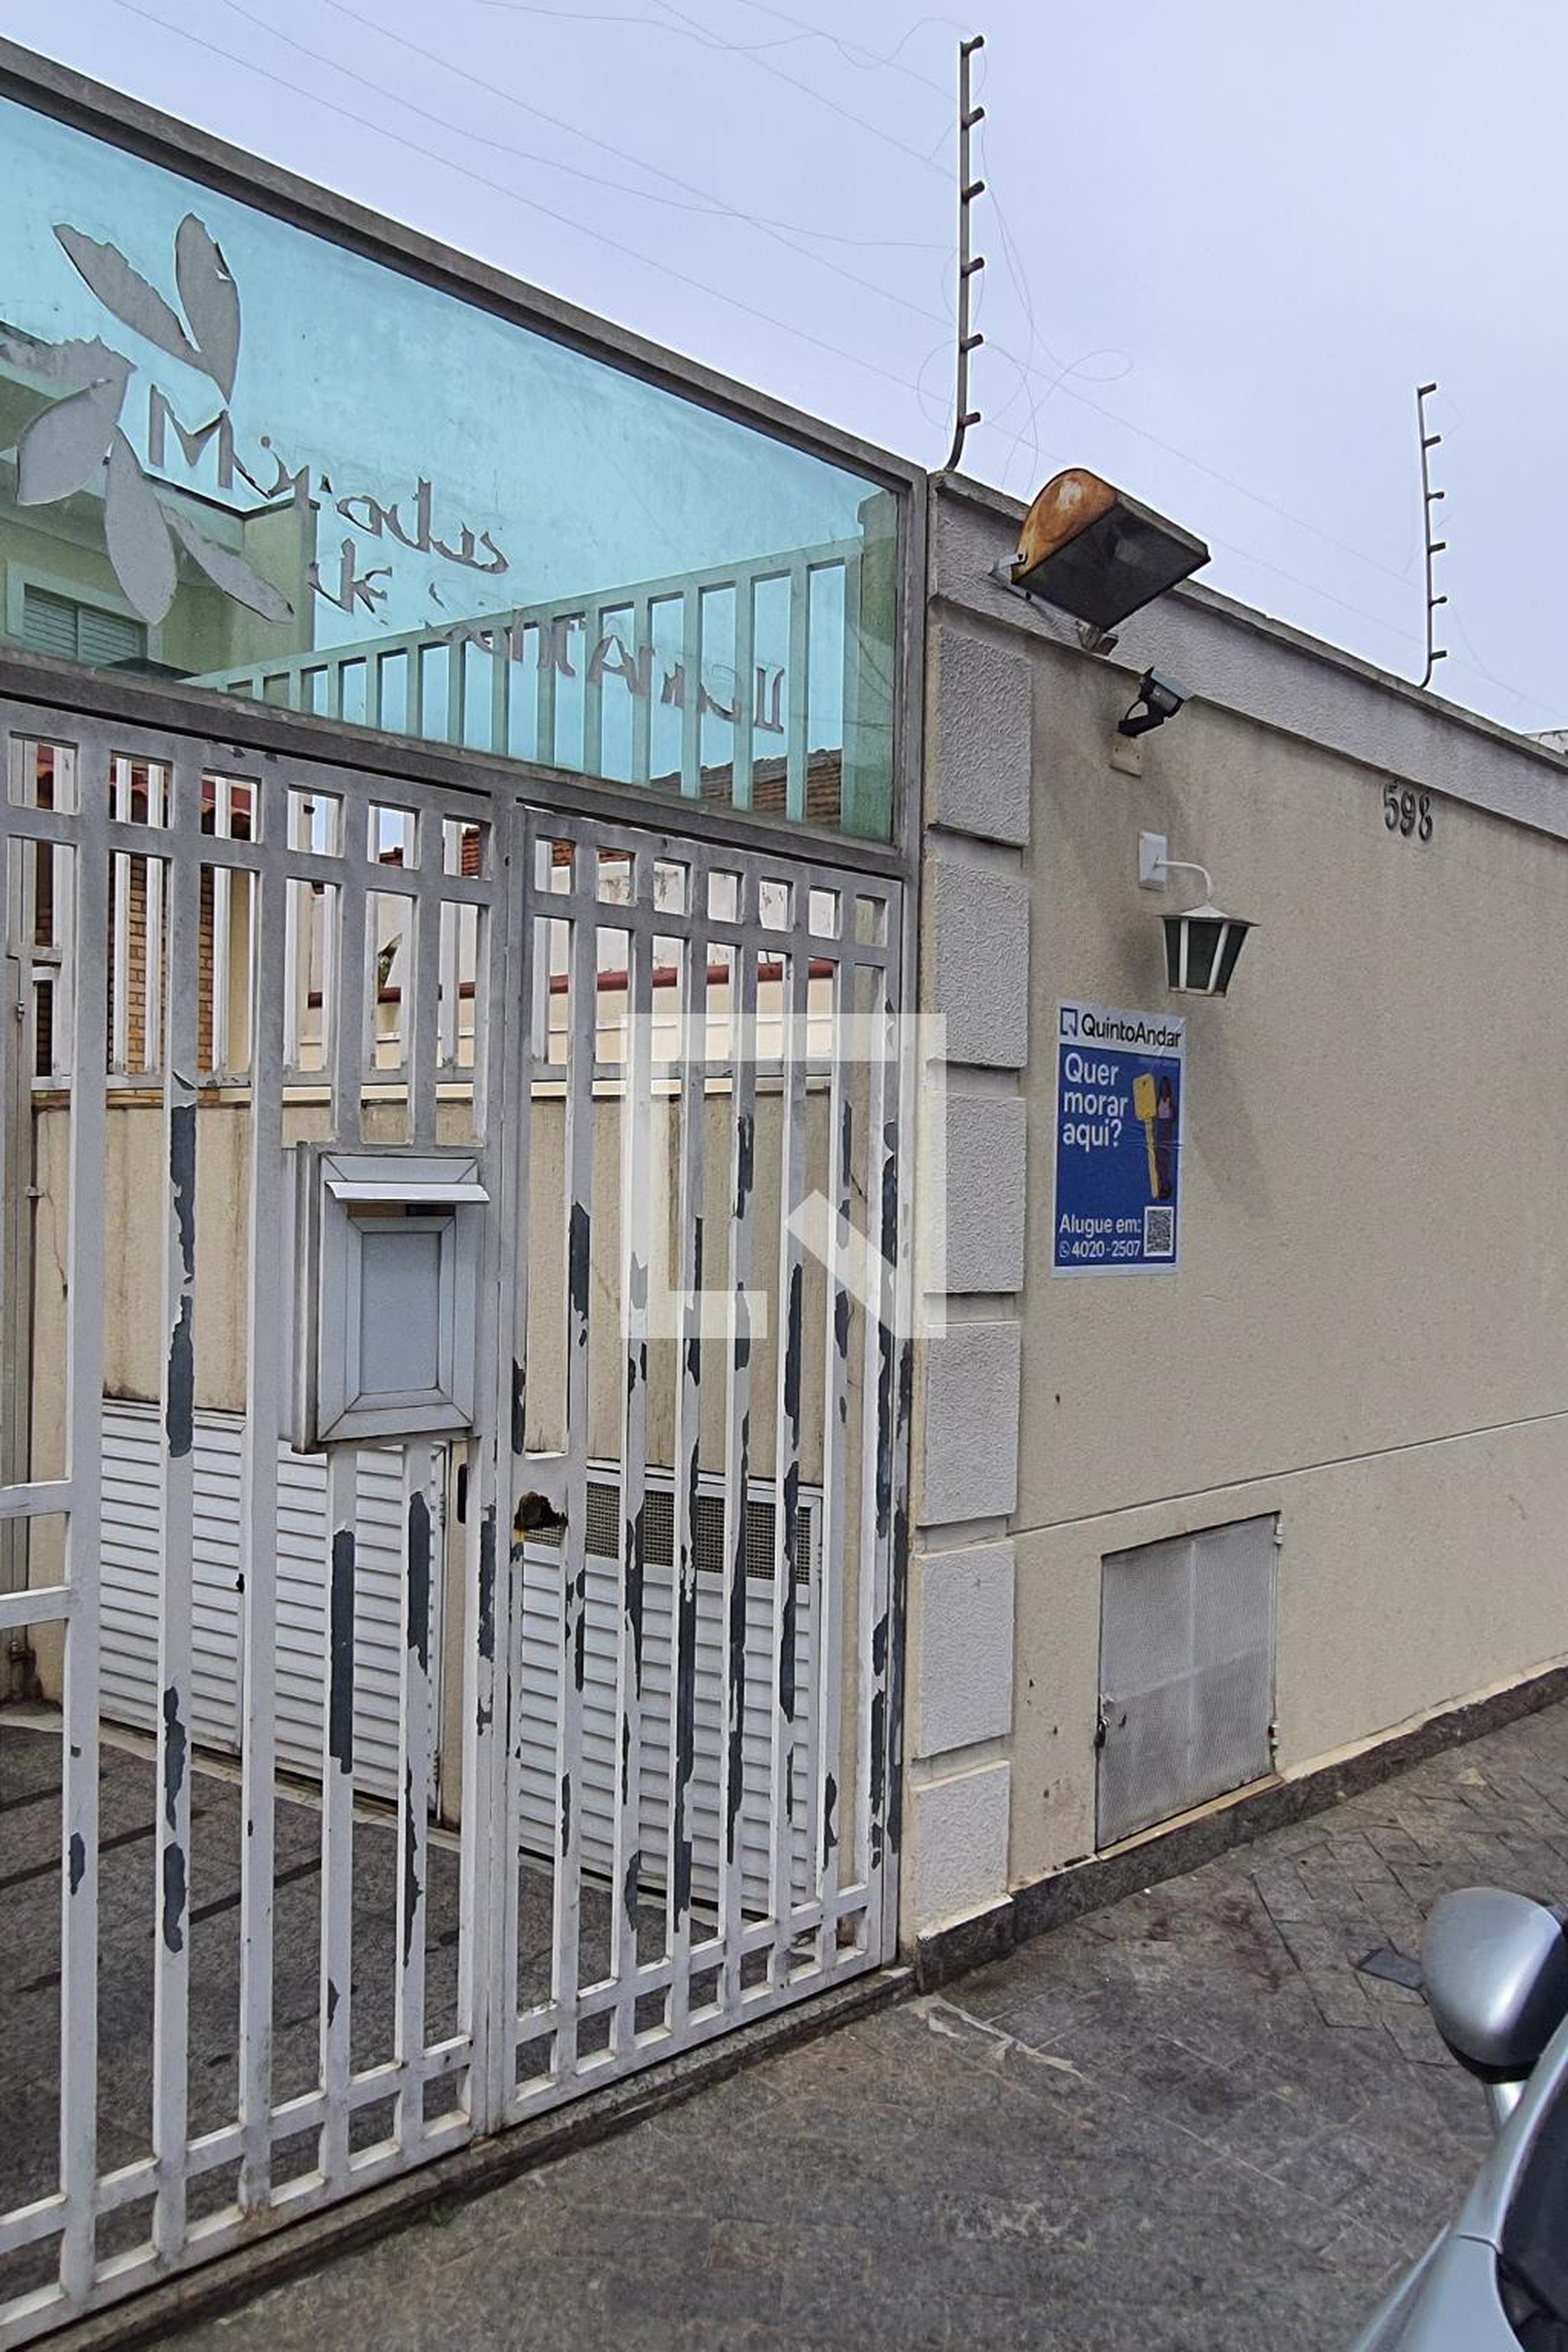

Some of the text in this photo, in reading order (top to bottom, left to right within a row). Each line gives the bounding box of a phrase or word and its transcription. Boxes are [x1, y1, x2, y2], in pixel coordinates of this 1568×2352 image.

[1383, 779, 1433, 841] 598
[1082, 1013, 1181, 1047] QuintoAndar
[1065, 1052, 1119, 1086] Quer
[1064, 1091, 1128, 1118] morar
[1062, 1118, 1122, 1152] aqui?
[1059, 1213, 1142, 1238] Alugue em:
[1071, 1240, 1141, 1258] 4020-2507
